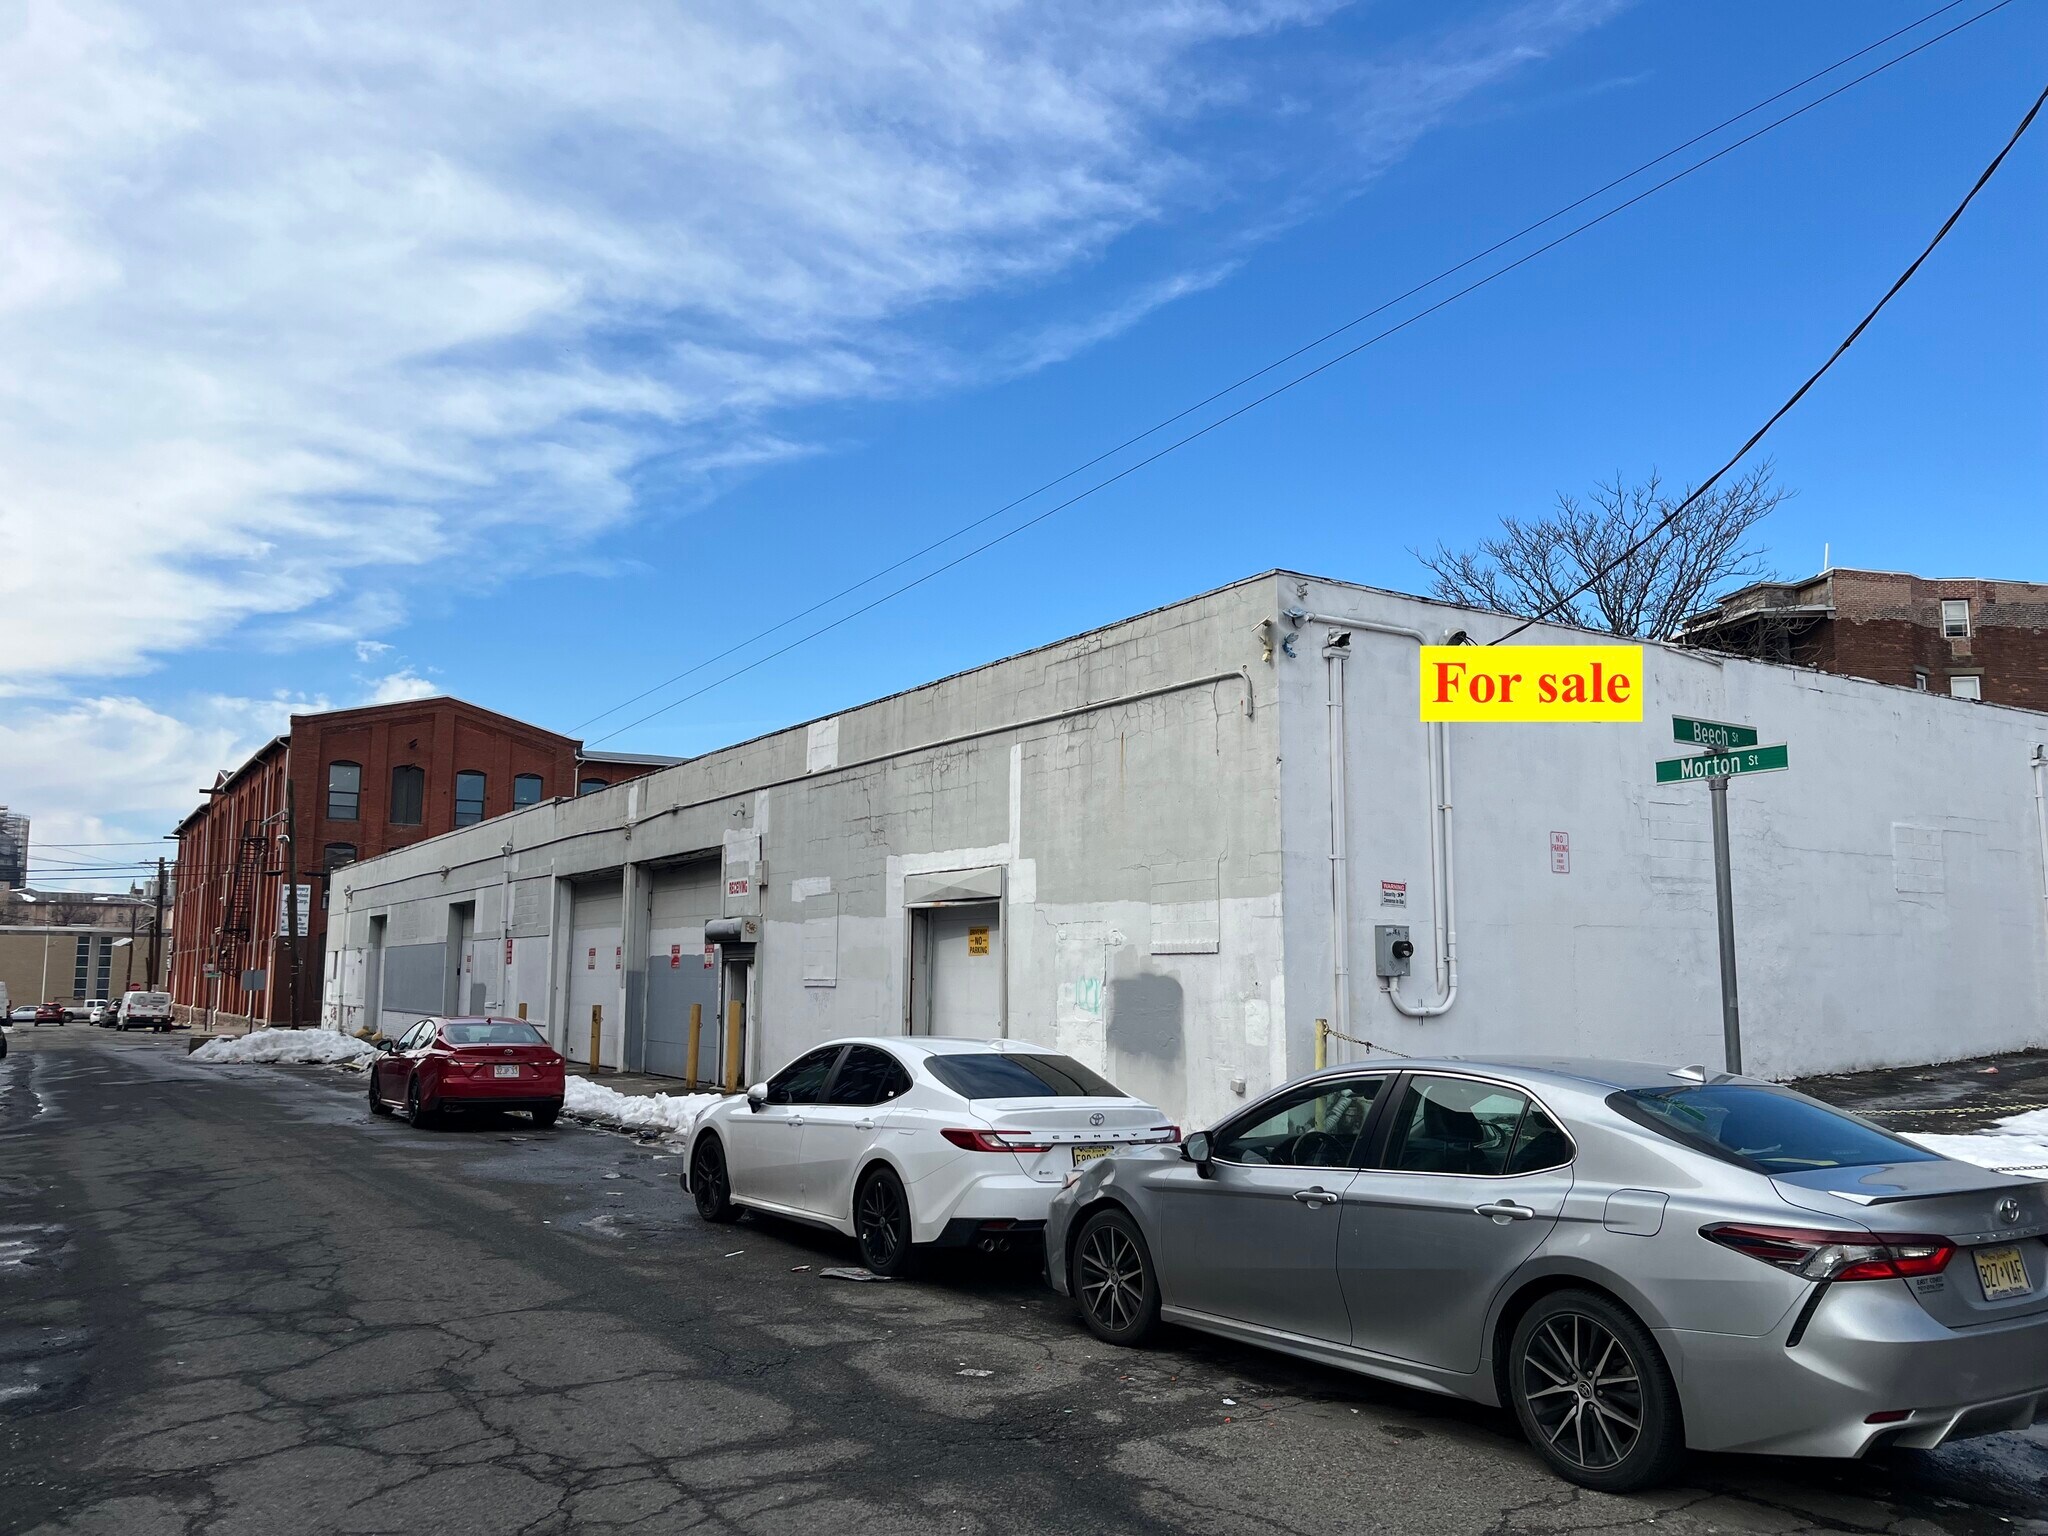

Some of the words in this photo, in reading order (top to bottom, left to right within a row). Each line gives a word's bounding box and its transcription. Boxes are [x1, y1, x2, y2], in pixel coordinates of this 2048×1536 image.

[1693, 722, 1728, 746] Beech
[1731, 731, 1739, 743] St
[1680, 754, 1741, 779] Morton
[1748, 754, 1759, 766] St
[1556, 835, 1564, 843] NO
[1552, 844, 1568, 852] PARKING
